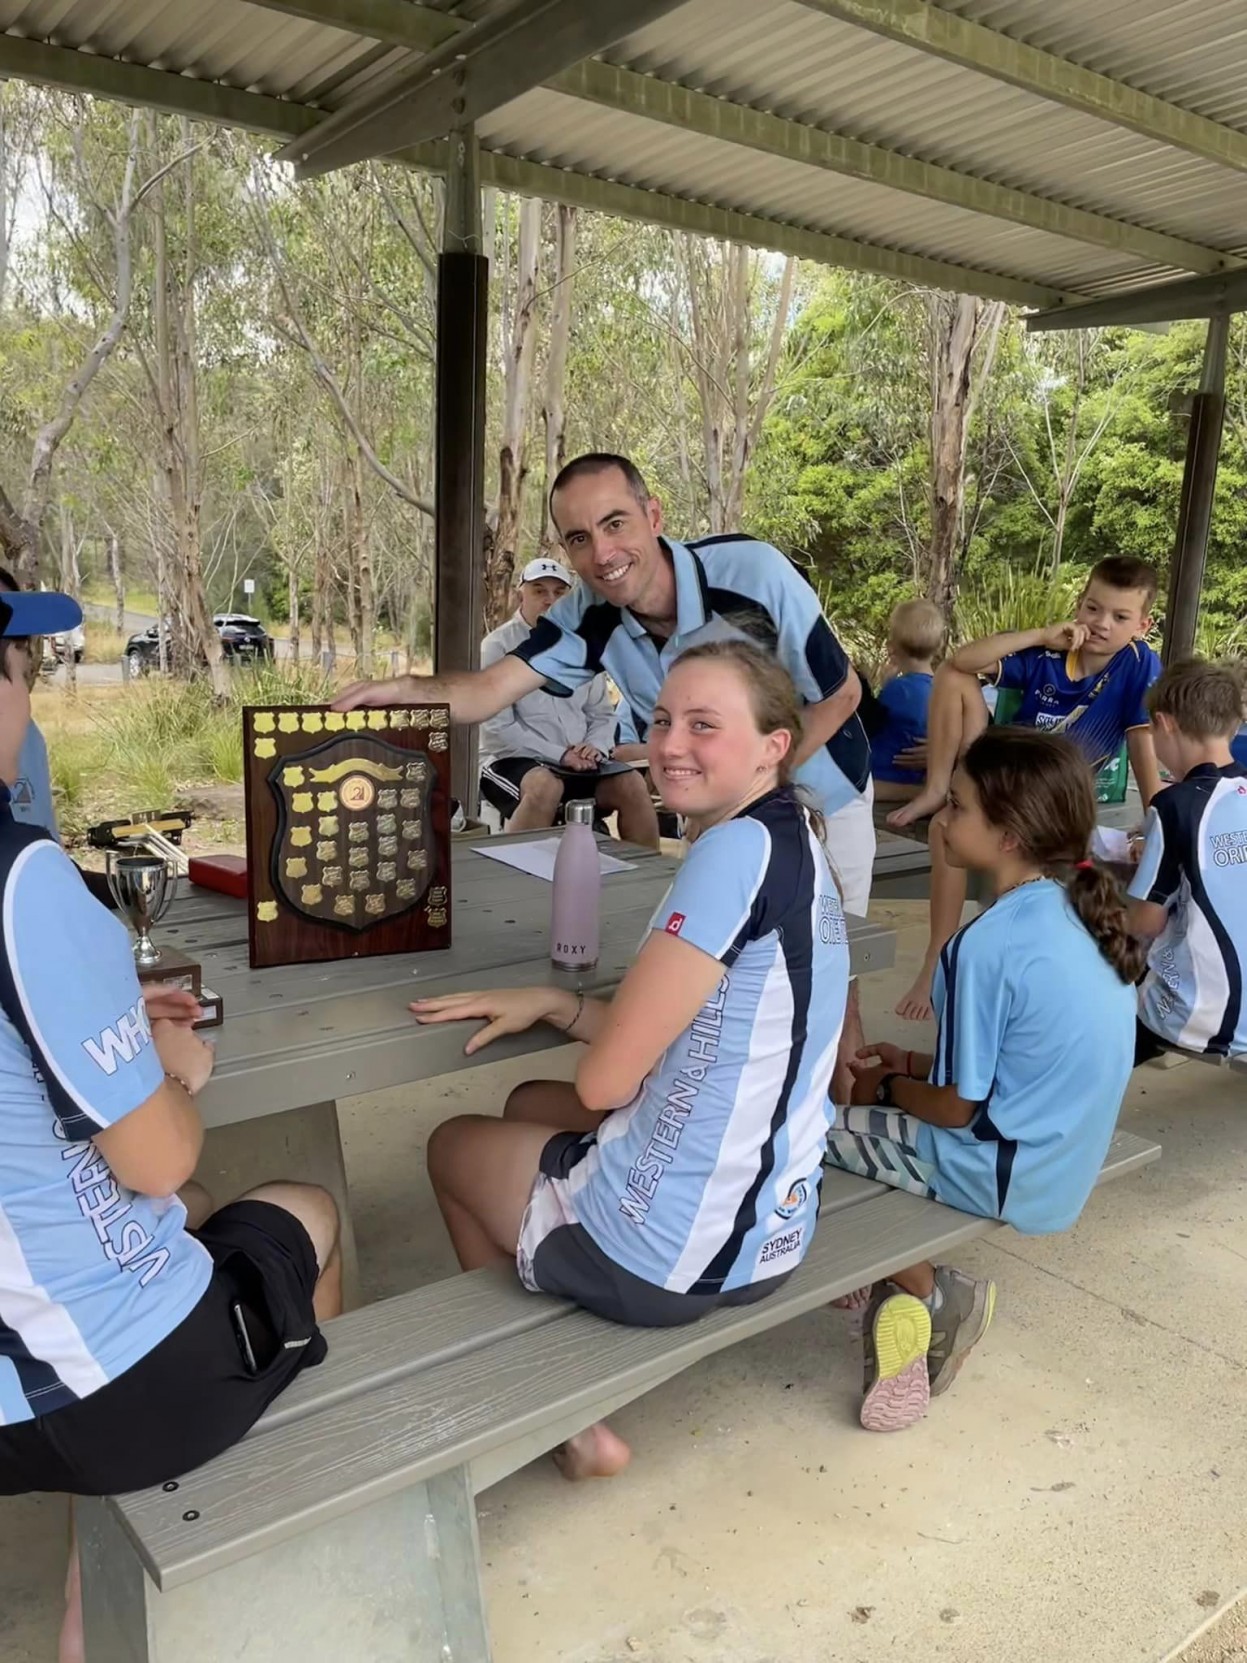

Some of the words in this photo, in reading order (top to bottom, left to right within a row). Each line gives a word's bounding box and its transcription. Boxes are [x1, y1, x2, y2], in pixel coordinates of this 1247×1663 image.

[557, 942, 586, 955] ROXY
[619, 1078, 698, 1225] WESTERN
[759, 1240, 801, 1265] AUSTRALIA
[761, 1228, 802, 1255] SYDNEY
